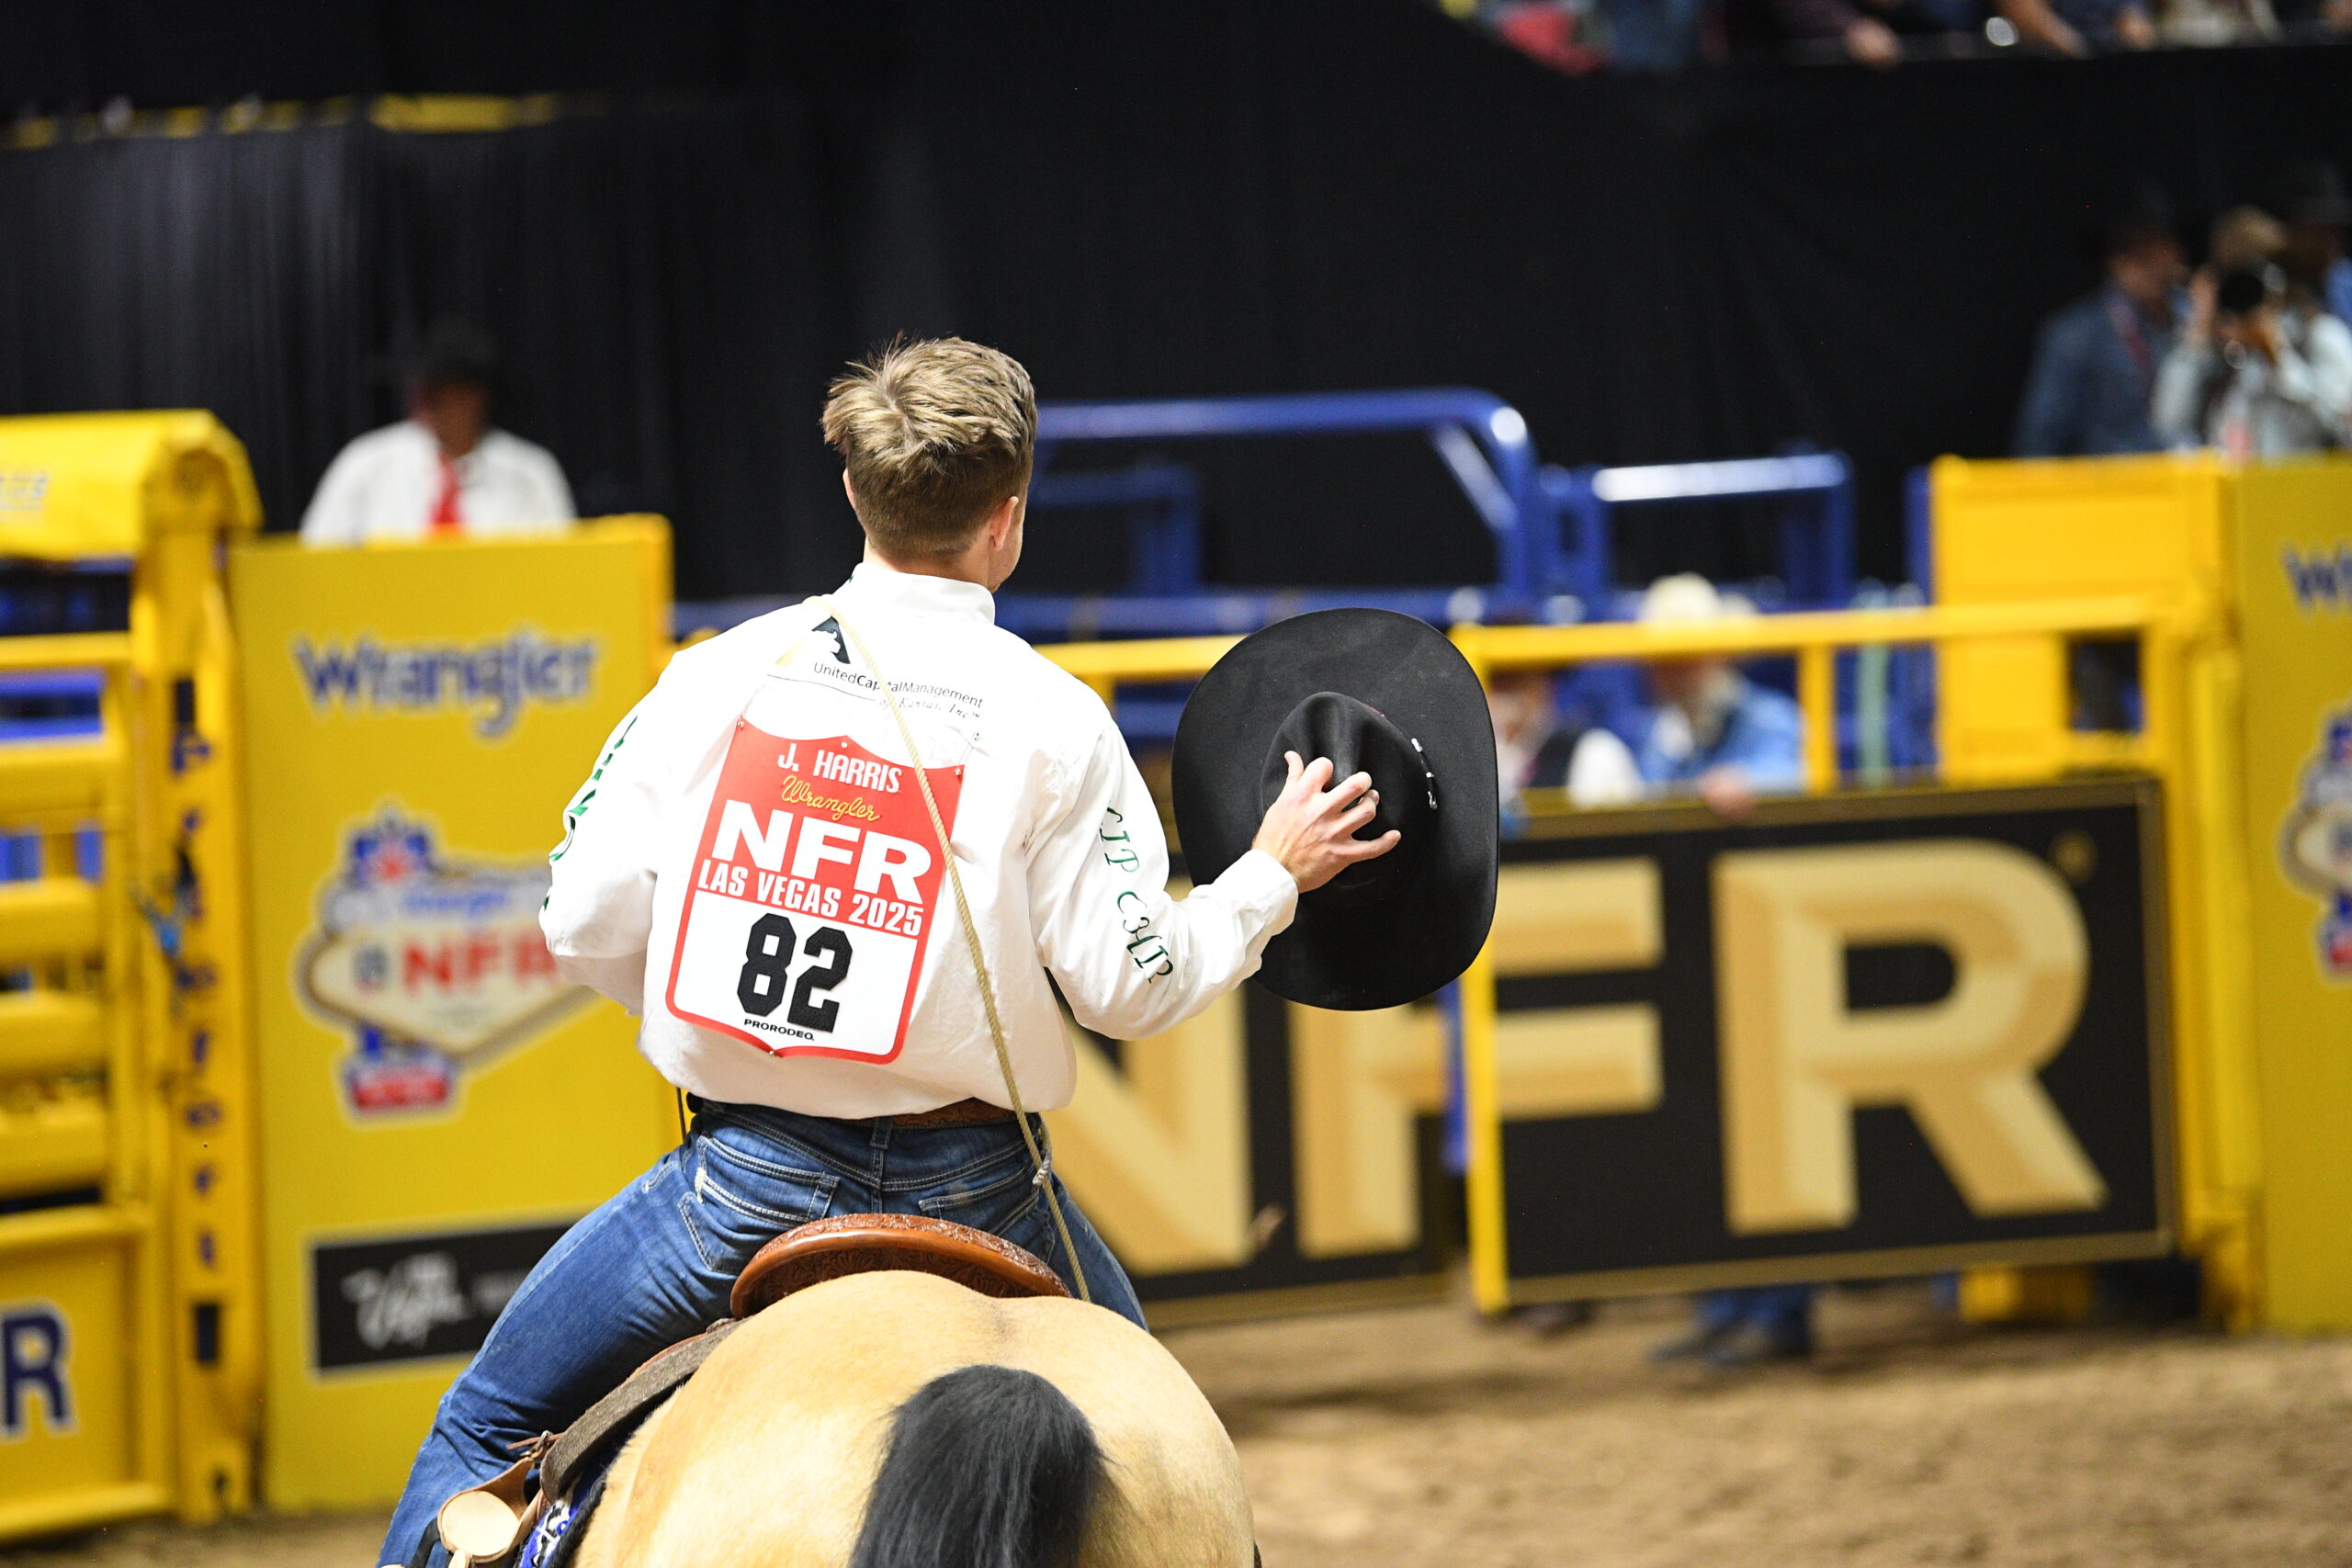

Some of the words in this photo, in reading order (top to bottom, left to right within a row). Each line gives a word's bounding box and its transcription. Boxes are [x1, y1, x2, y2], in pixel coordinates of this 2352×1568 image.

[292, 632, 596, 738] Wrangler
[814, 662, 984, 709] UnitedCapalManagement
[777, 742, 799, 773] J.
[812, 750, 902, 793] HARRIS
[781, 775, 880, 821] Wrangler
[711, 799, 932, 905] NFR
[697, 859, 749, 897] LAS
[756, 871, 842, 918] VEGAS
[848, 894, 924, 936] 2025
[737, 912, 853, 1033] 82
